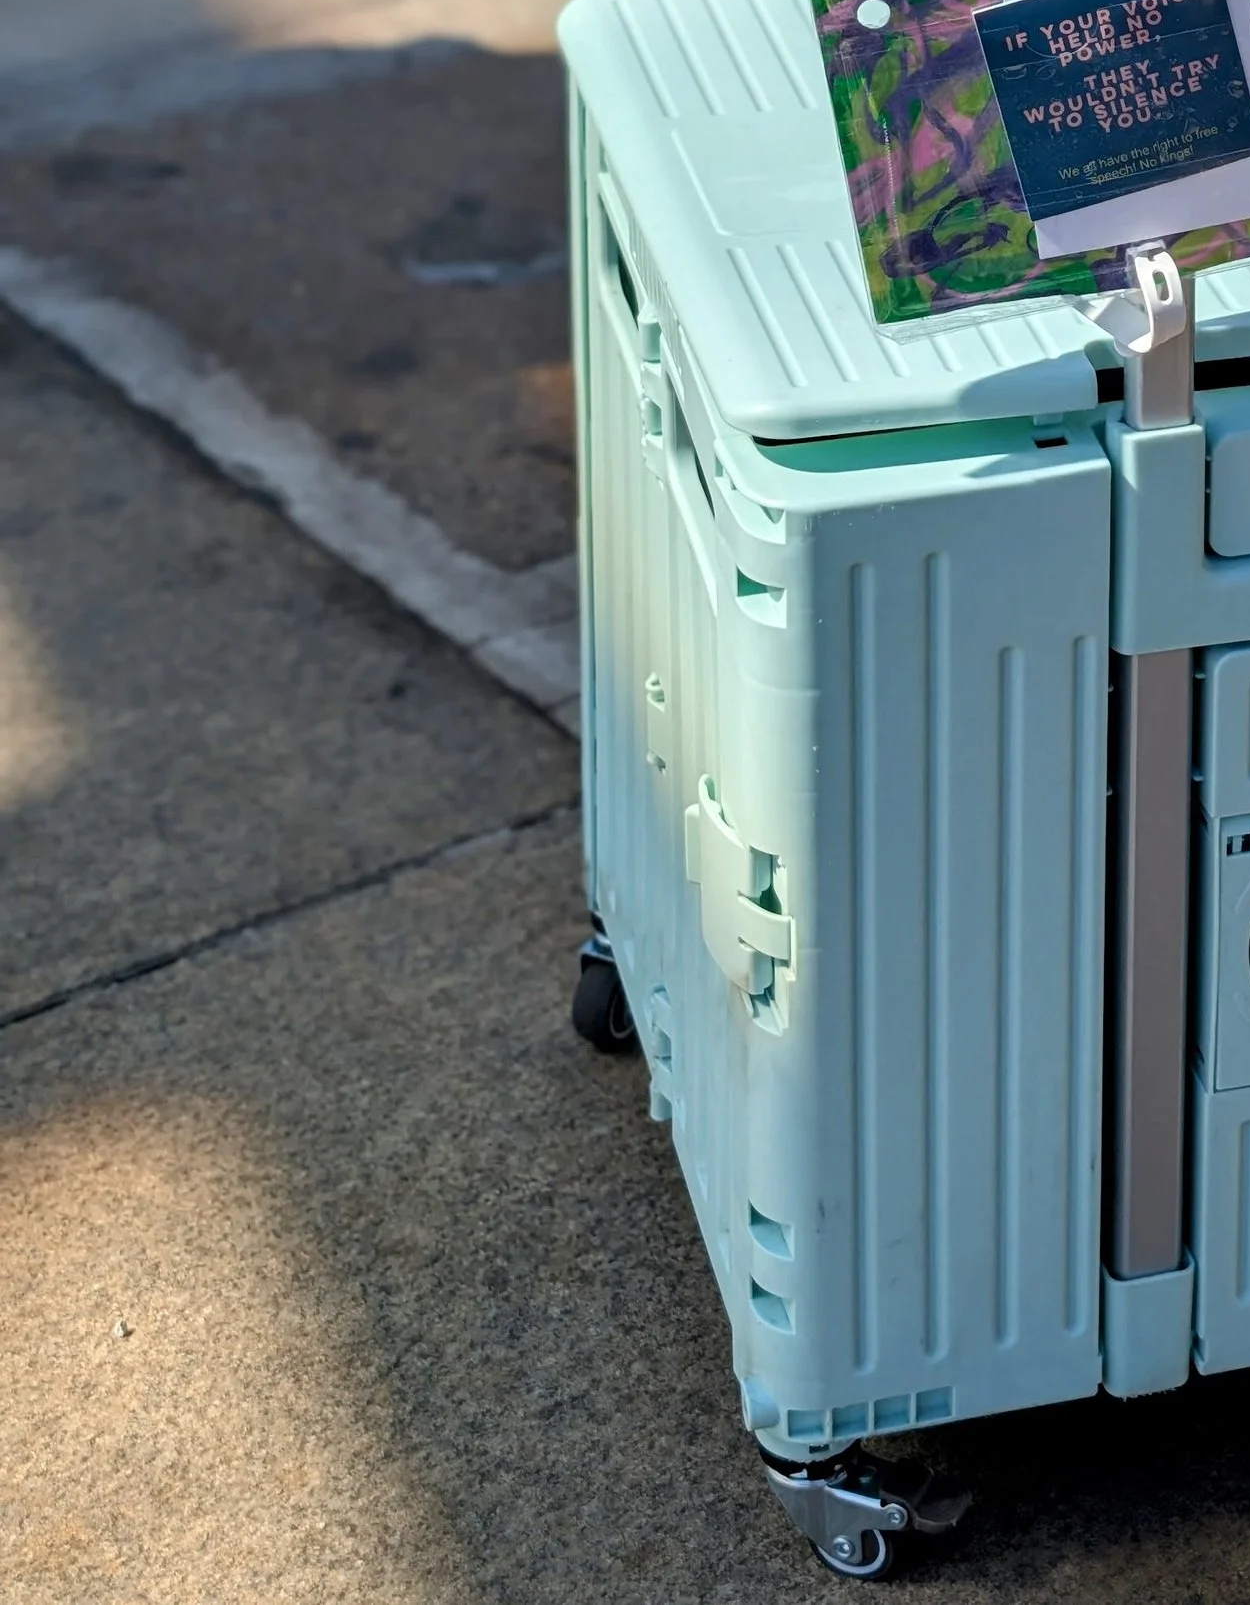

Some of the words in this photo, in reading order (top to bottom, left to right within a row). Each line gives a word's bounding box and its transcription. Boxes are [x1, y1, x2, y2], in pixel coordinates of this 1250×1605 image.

[1006, 32, 1028, 52] IF
[1039, 8, 1111, 40] YOUR
[1050, 24, 1115, 55] HELD
[1127, 9, 1162, 32] NO
[1084, 59, 1150, 90] THEY
[1171, 54, 1220, 81] TRY
[1023, 72, 1160, 124] WOULDN'T
[1049, 112, 1083, 133] TO
[1094, 77, 1203, 120] SILENCE
[1058, 166, 1080, 181] We
[1098, 152, 1128, 168] have
[1131, 146, 1150, 160] the
[1152, 136, 1180, 156] right
[1181, 132, 1194, 144] to
[1195, 126, 1219, 141] free
[1090, 164, 1138, 186] speech!
[1140, 157, 1158, 170] No
[1159, 145, 1195, 166] kings!
